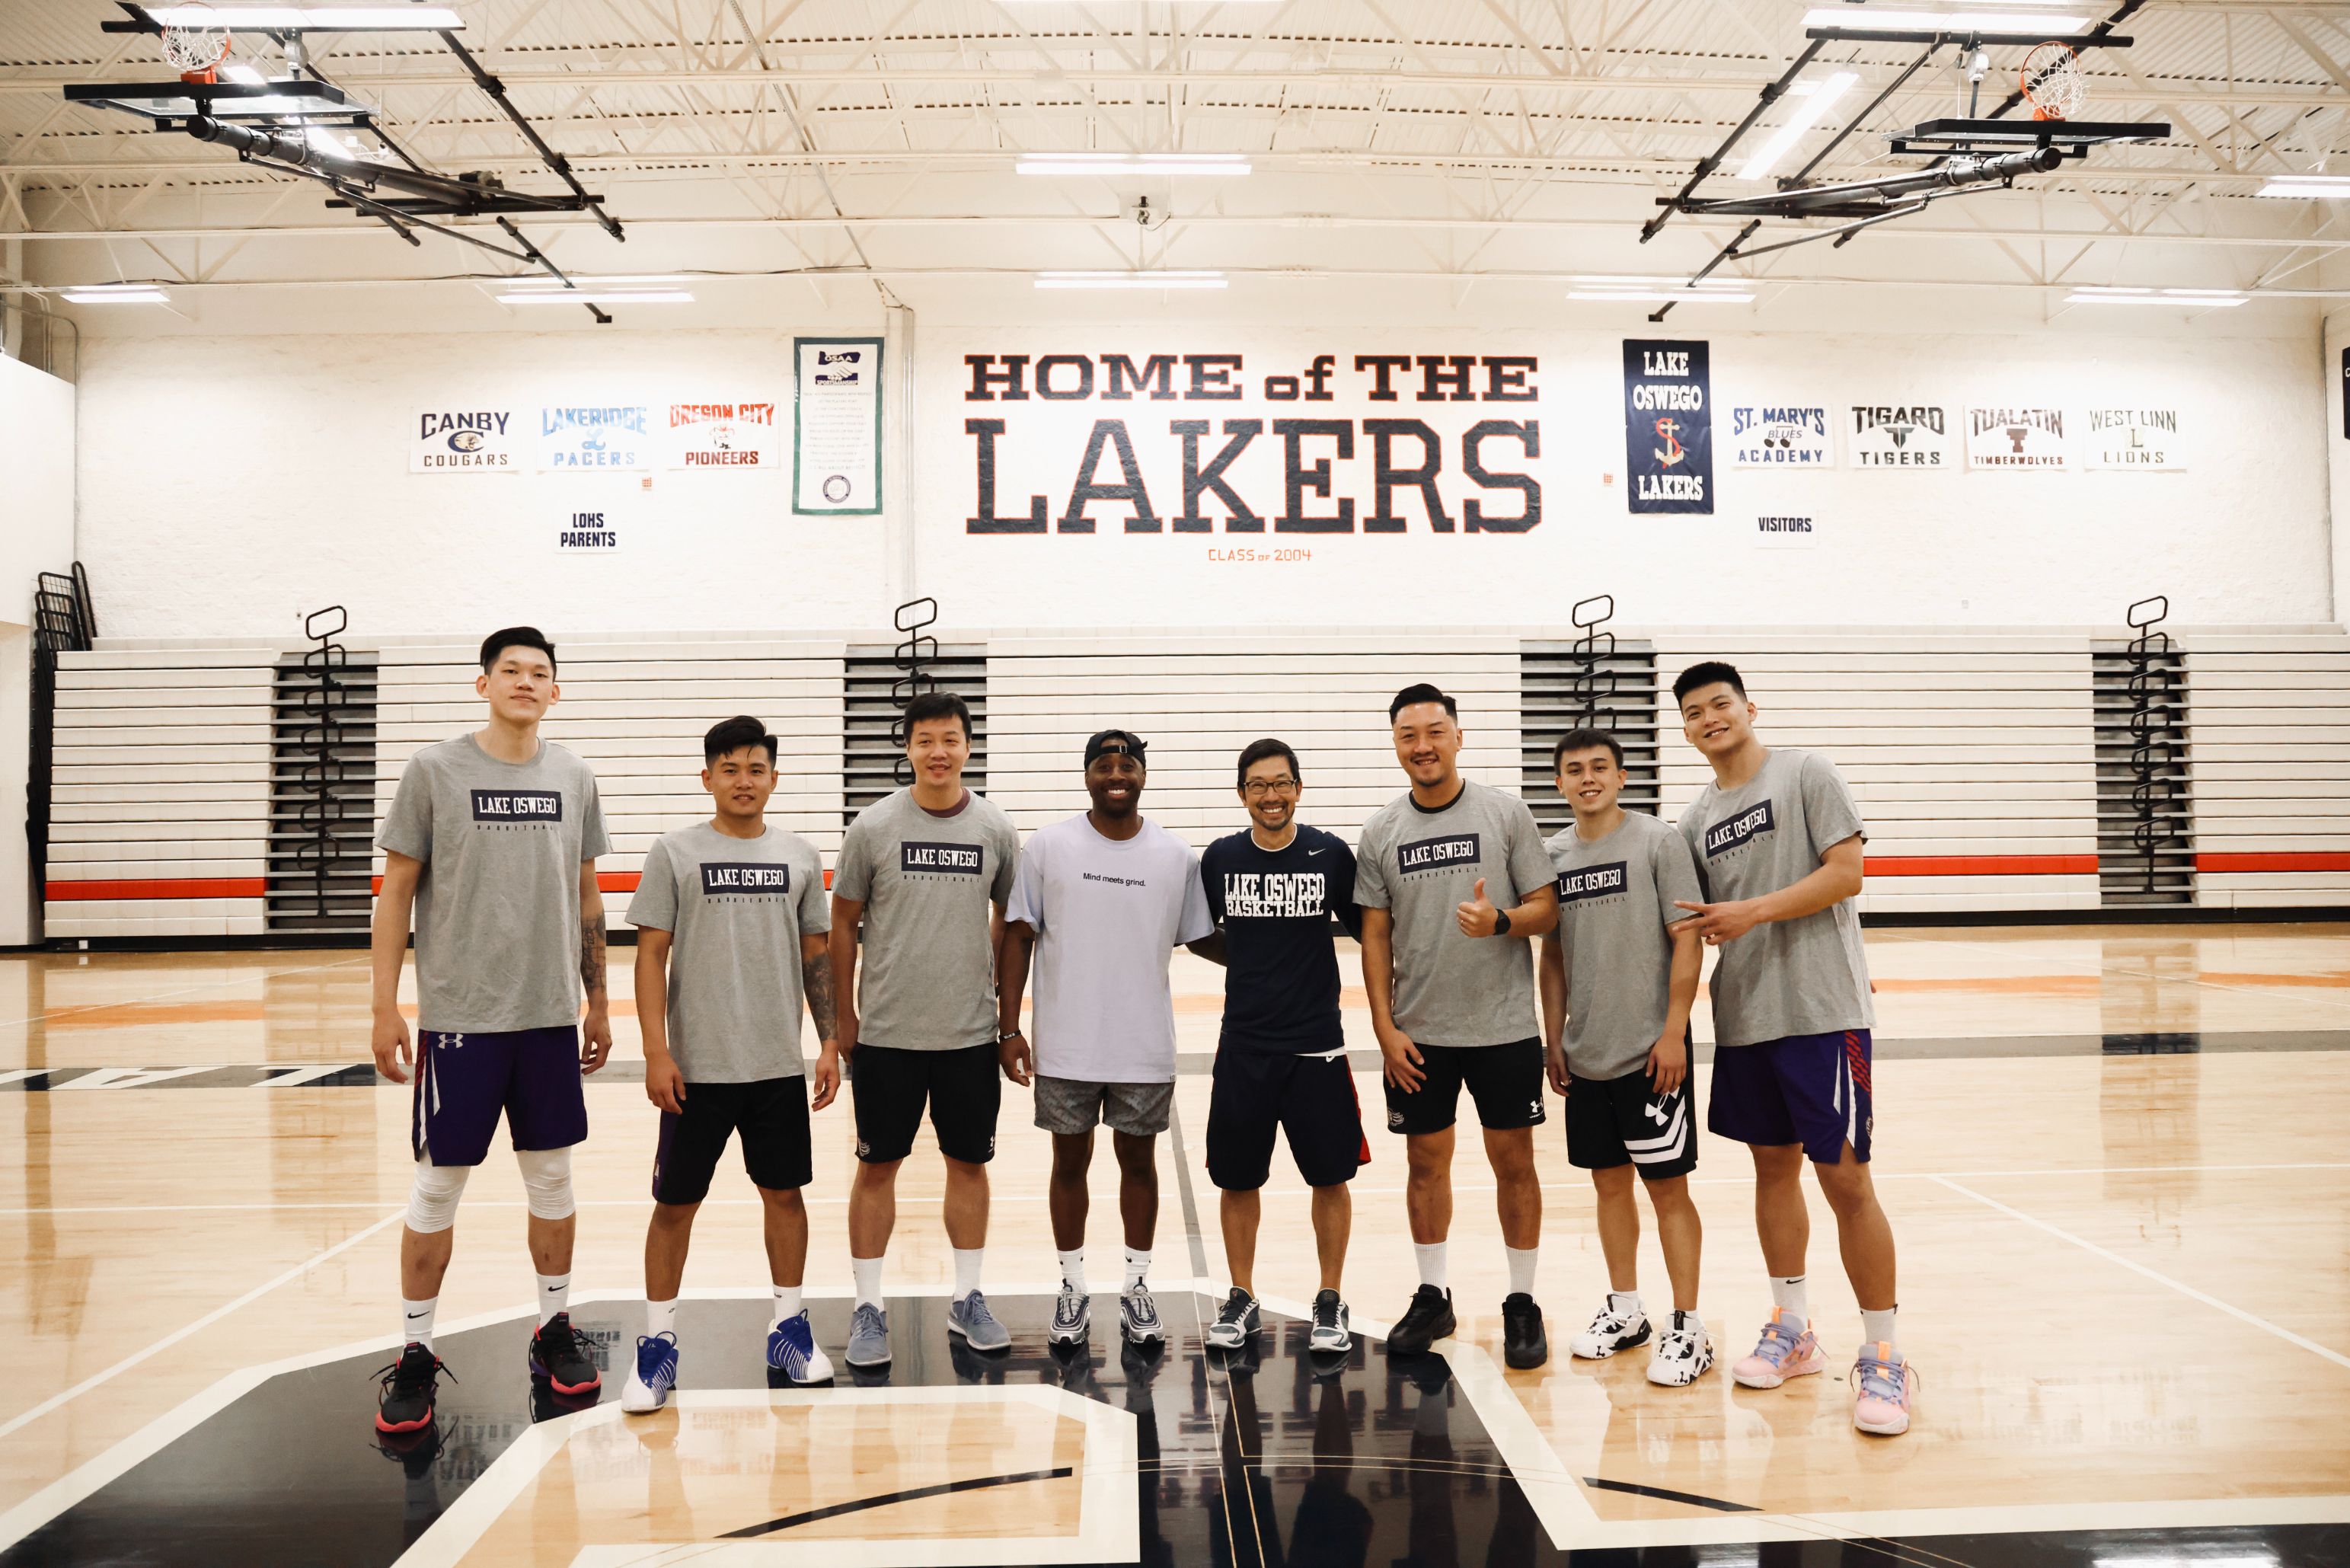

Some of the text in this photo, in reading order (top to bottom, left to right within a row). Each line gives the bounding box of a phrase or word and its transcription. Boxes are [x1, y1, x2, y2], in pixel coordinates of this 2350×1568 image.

[1643, 351, 1689, 376] LAKE
[964, 353, 1539, 402] HOME of THE
[1633, 385, 1703, 410] OSWEGO
[542, 407, 647, 436] LAKERIDGE
[670, 404, 774, 427] OREGON CITY
[1733, 407, 1825, 436] ST. MARY'S
[1852, 407, 1945, 435] TIGARD
[1970, 409, 2063, 439] TUALATIN
[2090, 410, 2176, 433] WEST LINN
[421, 412, 509, 440] CANBY
[1768, 430, 1802, 439] BLUES
[424, 454, 508, 467] COUGARS
[554, 452, 635, 466] PACERS
[685, 451, 758, 465] PIONEERS
[1739, 449, 1823, 462] ACADEMY
[1860, 452, 1940, 465] TIGERS
[1975, 456, 2063, 465] TIMBERWOLVES
[2104, 452, 2163, 464] LIONS
[965, 418, 1542, 535] LAKERS
[1638, 475, 1703, 501] LAKERS
[573, 513, 604, 528] LOHS
[1758, 517, 1812, 532] VISITORS
[560, 532, 616, 548] PARENTS
[1209, 549, 1255, 561] CLASS
[1274, 549, 1311, 561] 2004
[477, 797, 557, 814] LAKE OSWEGO
[1708, 807, 1767, 850] LAKE OSWEGO
[907, 848, 978, 867] LAKE OSWEGO
[1403, 840, 1474, 867] LAKE OSWEGO
[707, 869, 784, 886] LAKE OSWEGO
[1083, 873, 1146, 886] Mind meets grind.
[1224, 873, 1325, 901] LAKE OSWEGO
[1560, 869, 1620, 896] LAKE OSWEGO
[1225, 899, 1323, 918] BASKETBALL
